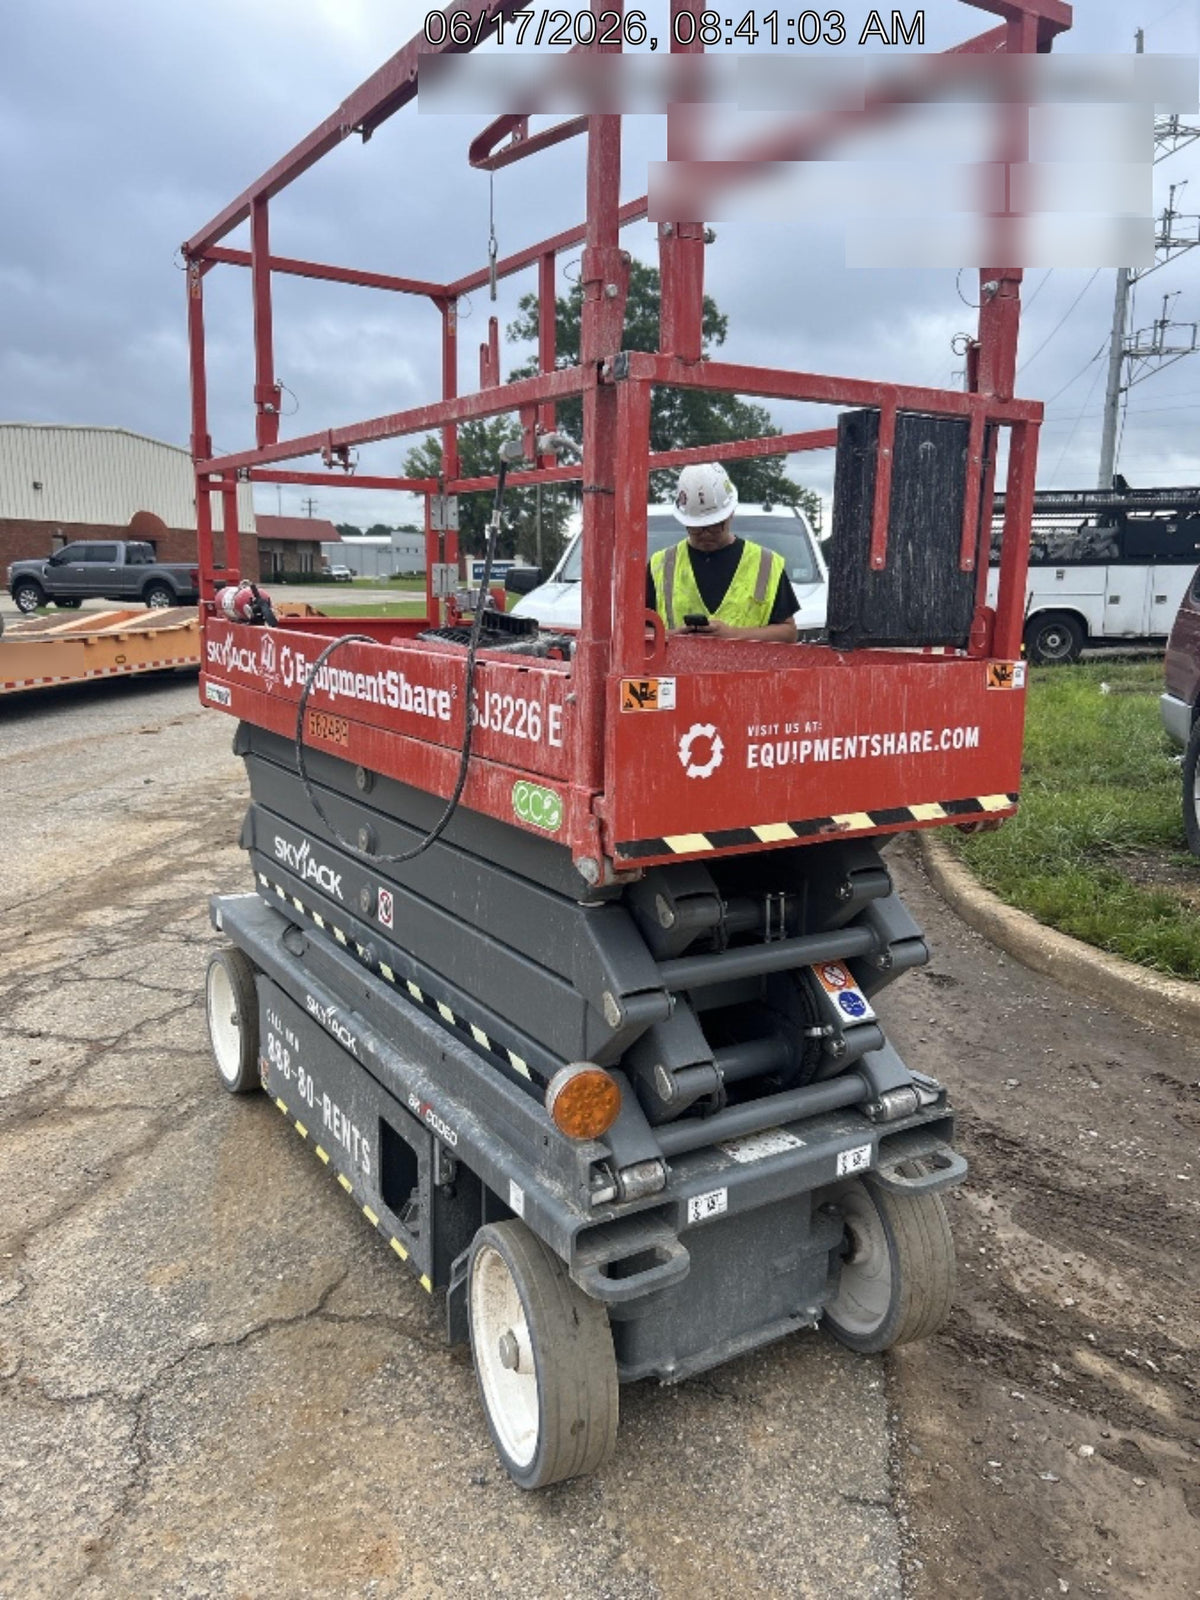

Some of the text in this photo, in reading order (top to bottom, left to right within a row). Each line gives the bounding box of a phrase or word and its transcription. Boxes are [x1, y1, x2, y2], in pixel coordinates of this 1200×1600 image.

[207, 632, 261, 676] SKYJACK
[294, 652, 451, 721] EquipmentShare
[548, 703, 563, 748] E
[746, 726, 980, 769] EQUIPMENTSHARE.COM
[747, 721, 823, 737] VISIT US AT:
[275, 834, 344, 901] SKYJACK
[306, 994, 358, 1056] SKYJACK
[267, 1032, 371, 1176] 888-80-RENTS
